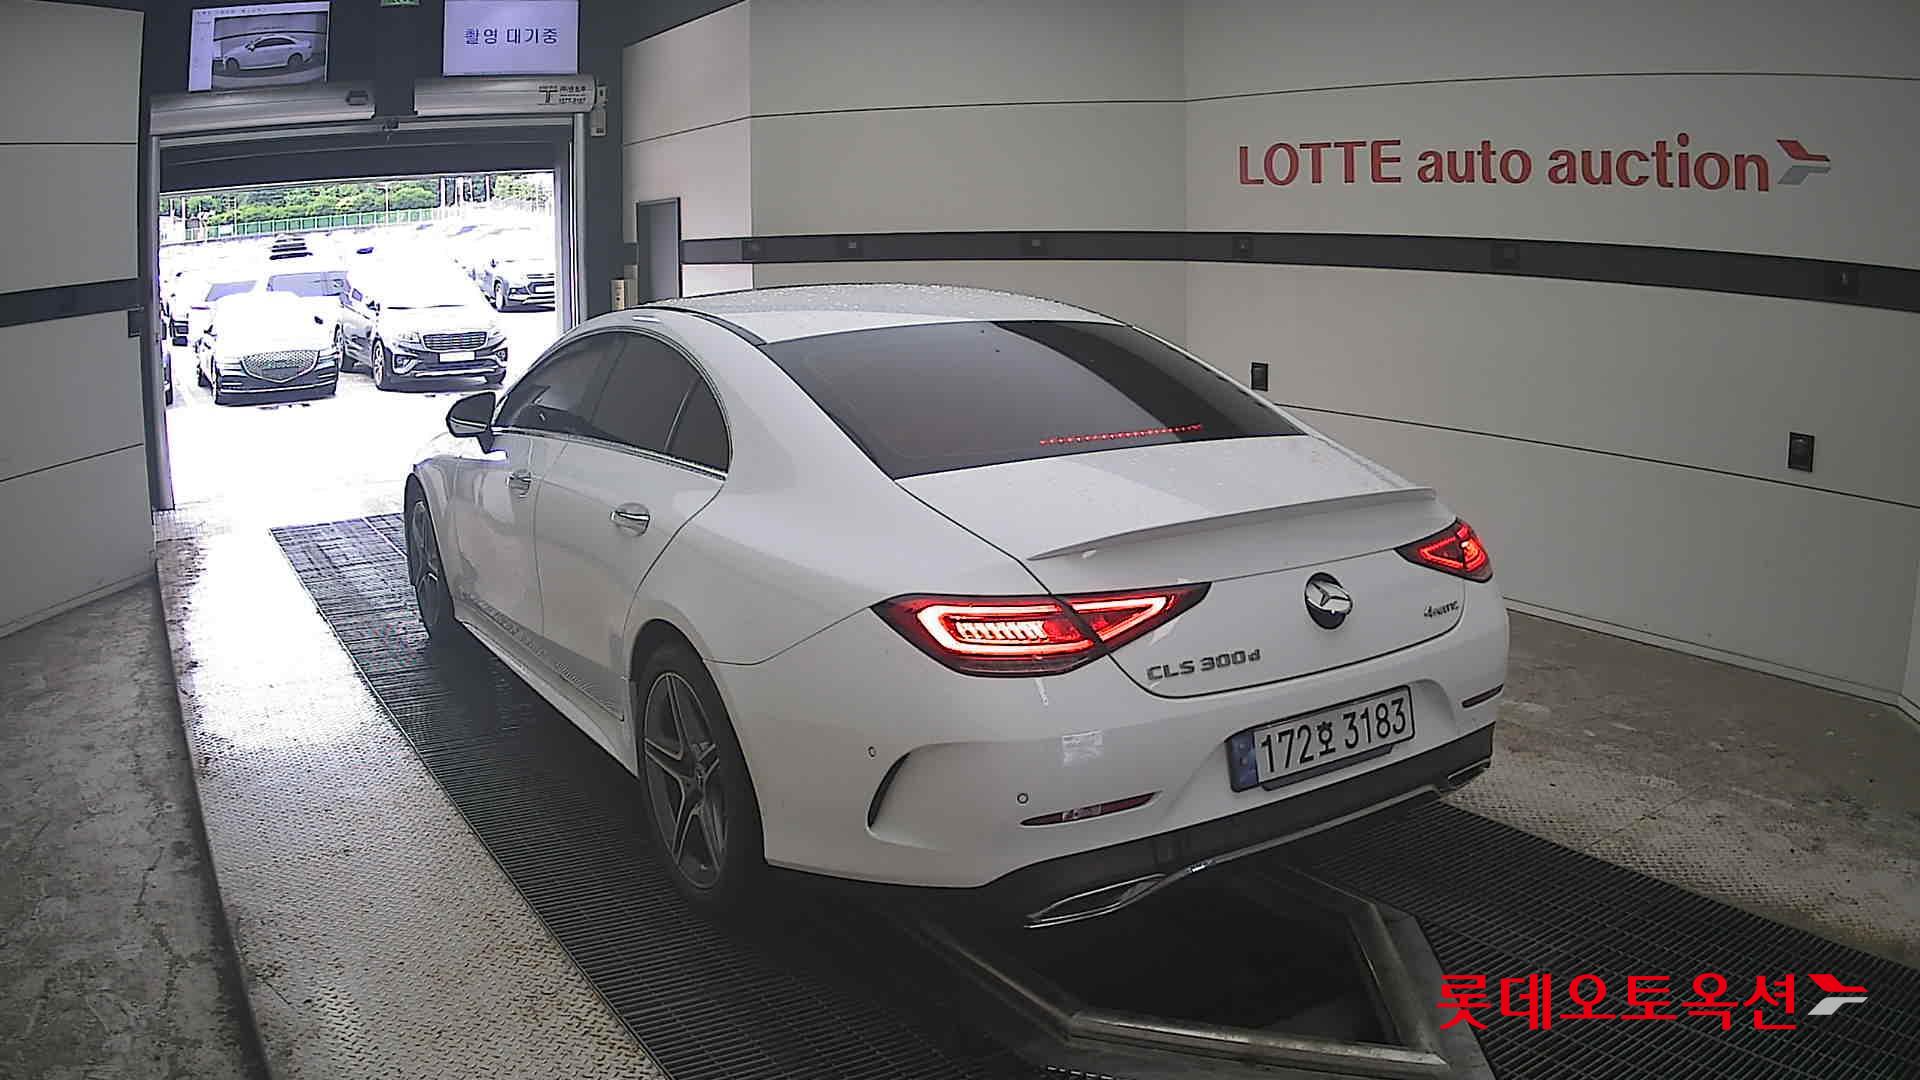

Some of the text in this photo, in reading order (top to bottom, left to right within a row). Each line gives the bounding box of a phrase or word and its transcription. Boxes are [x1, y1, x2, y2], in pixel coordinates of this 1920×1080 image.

[506, 28, 558, 45] 대기중
[1239, 132, 1769, 192] LOTTE auto auction
[1146, 649, 1261, 681] CLS 300d
[1260, 697, 1407, 773] 172호 3183
